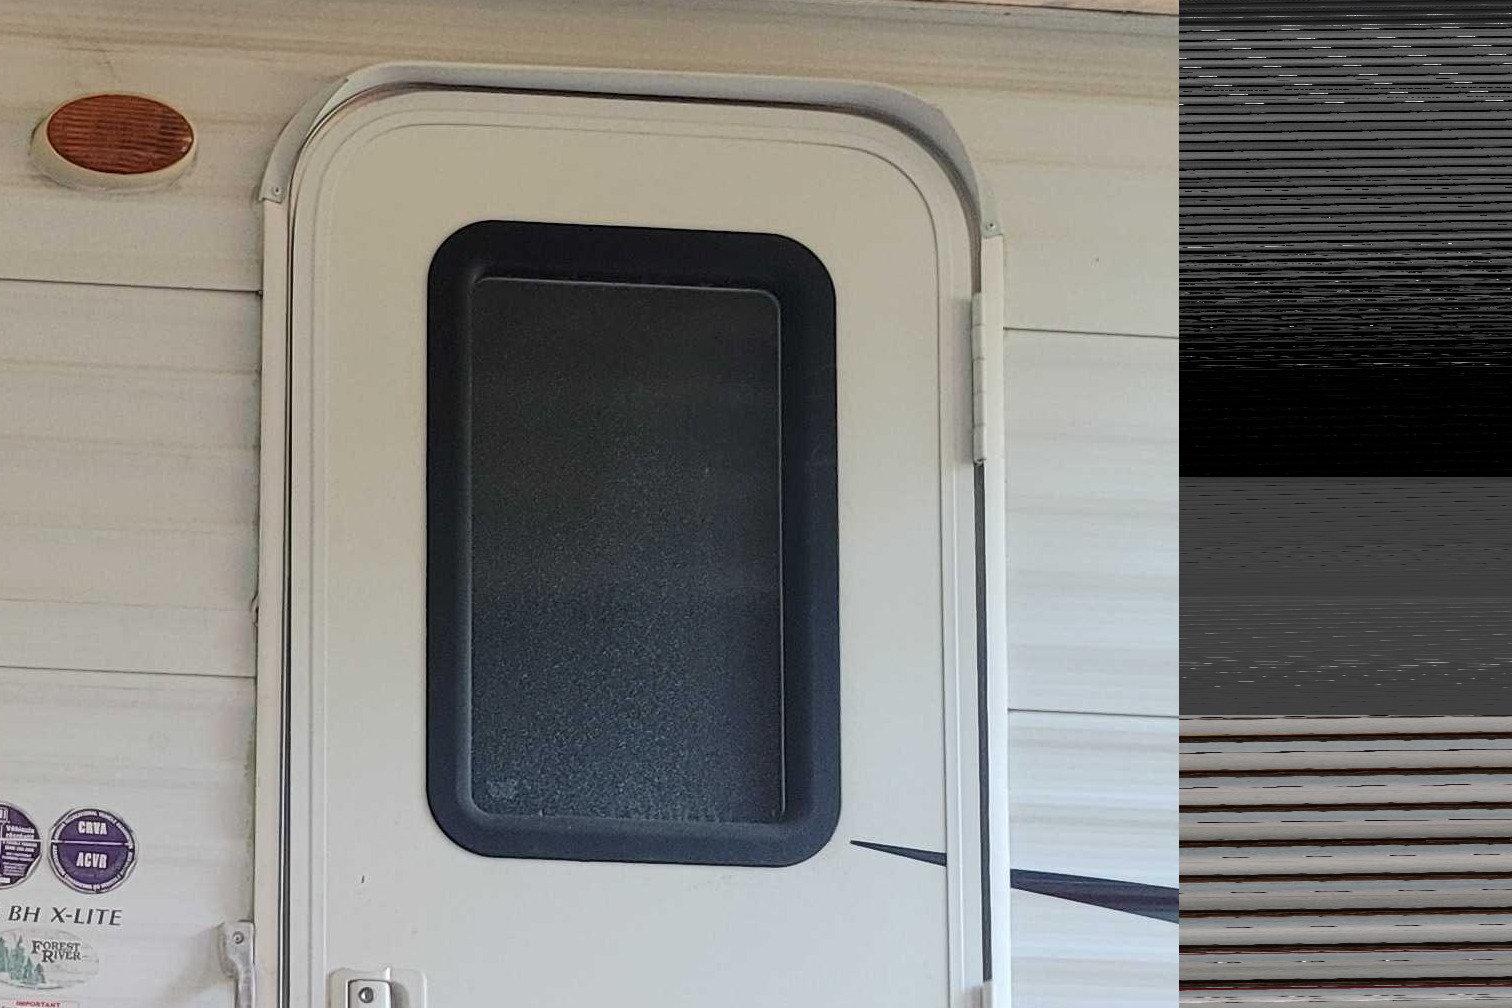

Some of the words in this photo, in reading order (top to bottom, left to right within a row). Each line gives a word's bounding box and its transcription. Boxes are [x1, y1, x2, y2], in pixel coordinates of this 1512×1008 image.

[77, 820, 108, 835] CRVA
[8, 905, 41, 922] BH
[51, 907, 123, 926] X-LITE
[31, 940, 81, 954] FOREST
[42, 950, 81, 963] RIVER
